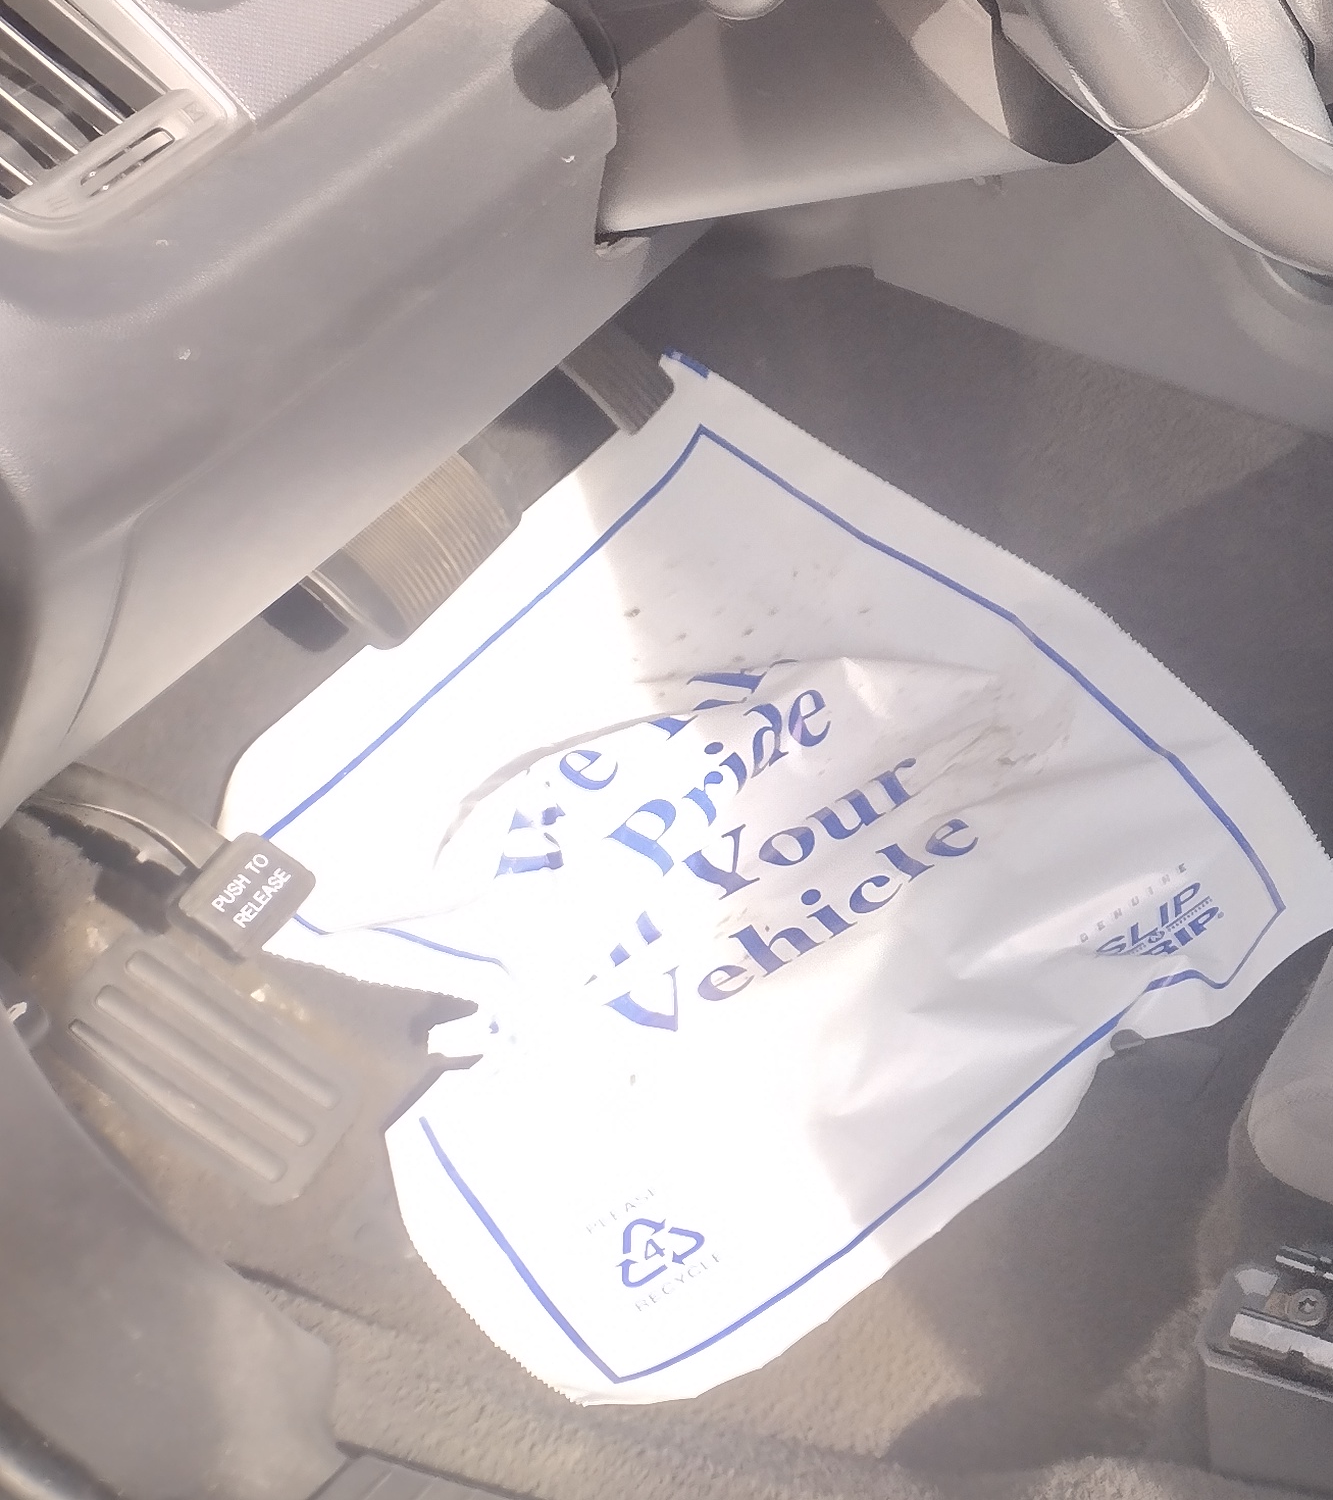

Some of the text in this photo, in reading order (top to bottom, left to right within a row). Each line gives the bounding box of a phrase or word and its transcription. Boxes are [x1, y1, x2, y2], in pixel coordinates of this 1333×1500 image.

[603, 689, 831, 876] Pride
[681, 757, 916, 900] Your
[210, 853, 270, 914] PUSH TO
[232, 868, 292, 929] RELEASE
[1079, 862, 1187, 943] GENUINE
[1096, 882, 1201, 955] SLIP
[603, 818, 979, 1032] Vehicle
[635, 1252, 721, 1312] RECYCLE
[644, 1238, 665, 1260] 4
